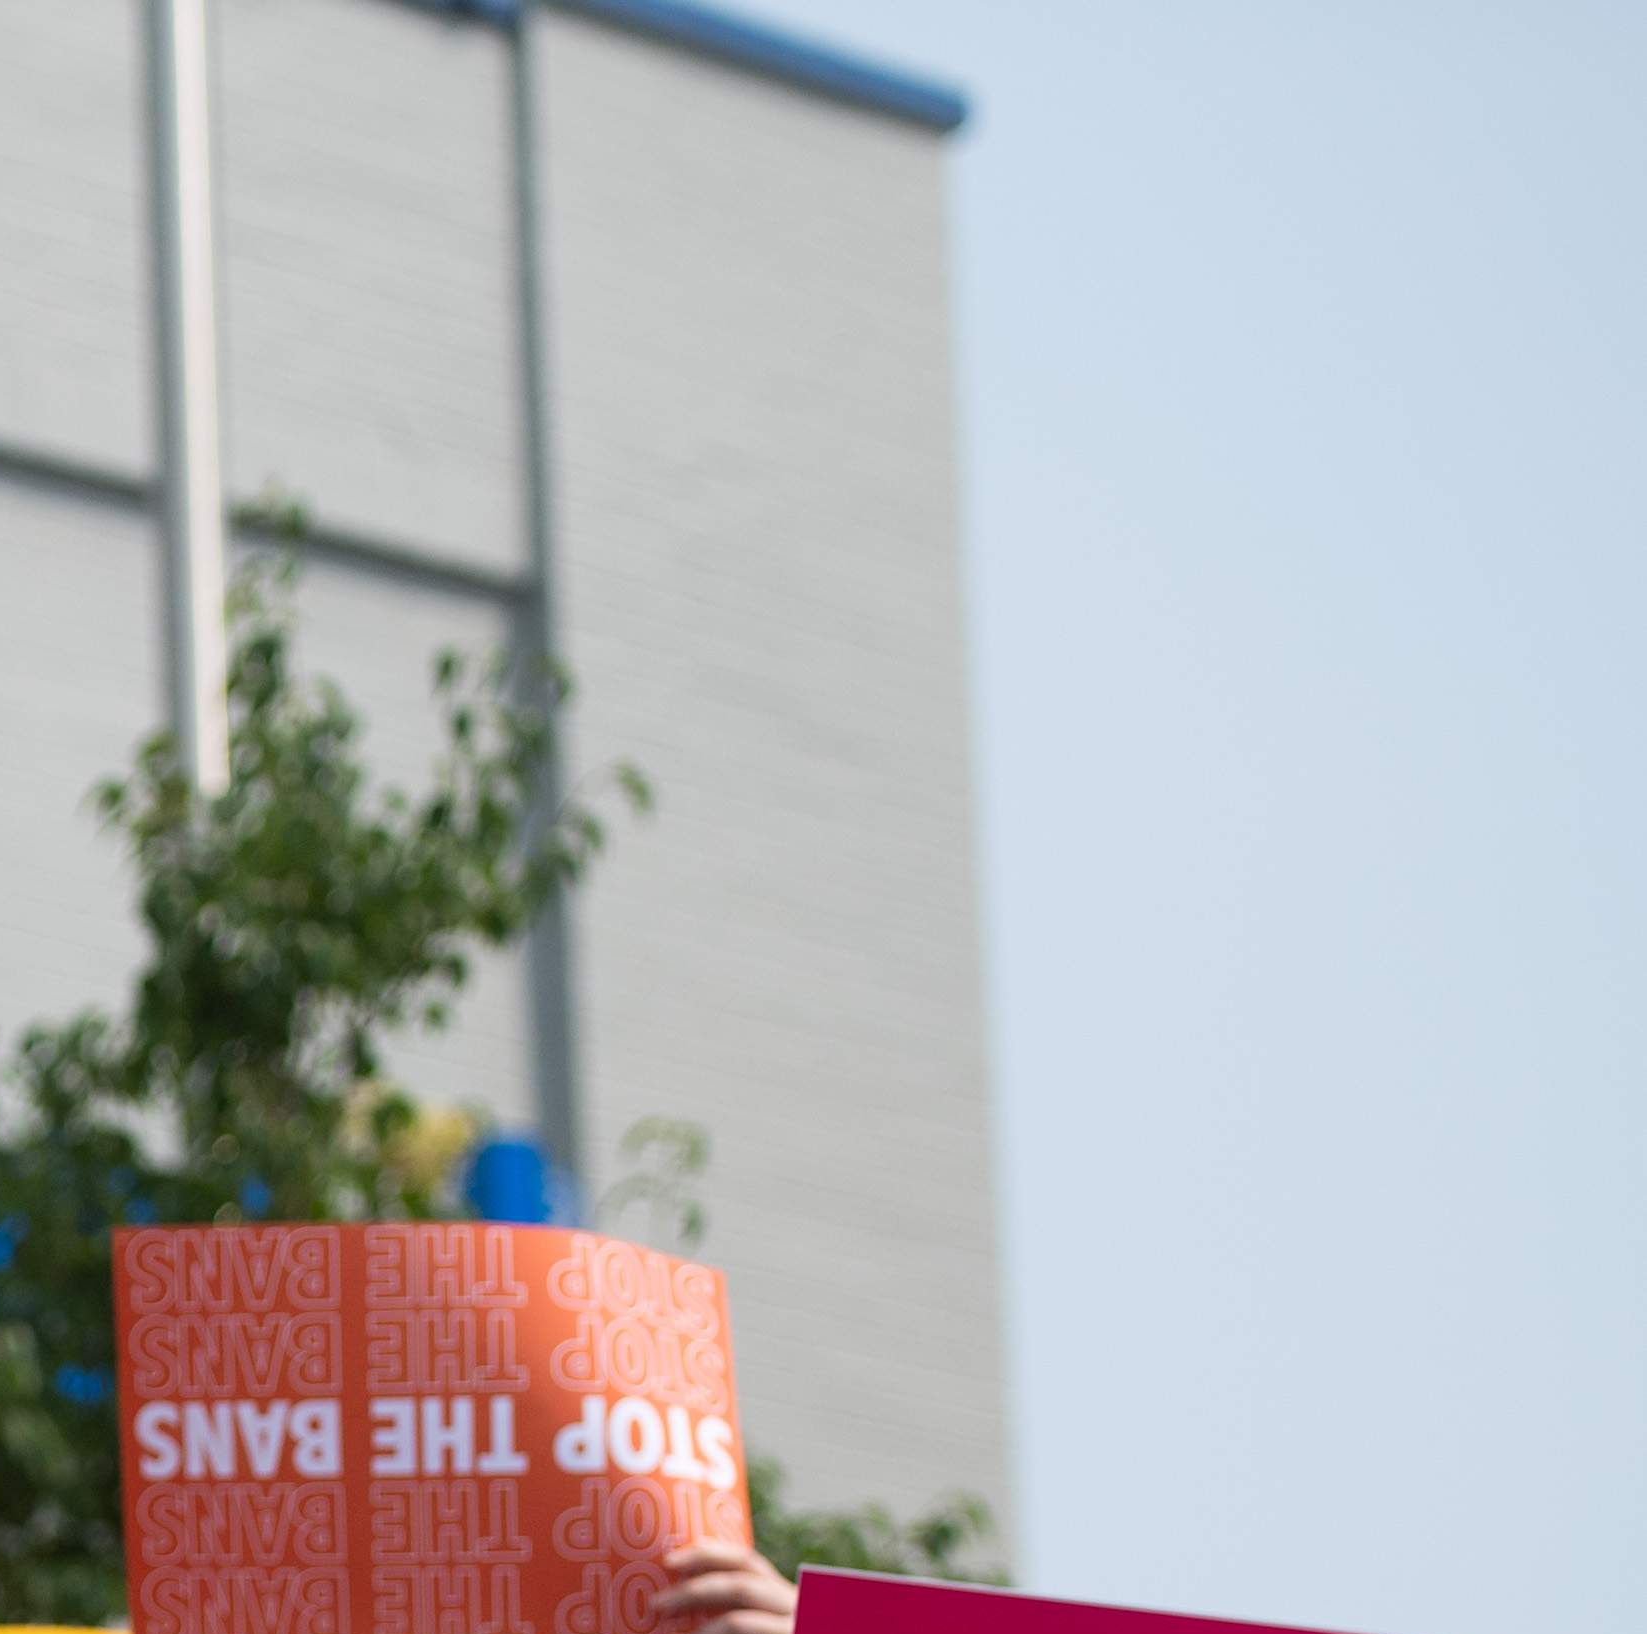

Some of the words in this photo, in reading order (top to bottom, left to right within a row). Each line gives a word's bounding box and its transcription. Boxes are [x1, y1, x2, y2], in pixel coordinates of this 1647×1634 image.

[124, 1226, 342, 1315] BANS
[364, 1223, 529, 1310] THE
[547, 1233, 721, 1341] STOP
[127, 1311, 344, 1399] BANS
[365, 1308, 531, 1394] THE
[548, 1311, 730, 1418] STOP
[133, 1397, 344, 1482] BANS
[369, 1394, 529, 1480] THE
[552, 1394, 737, 1491] STOP
[136, 1481, 346, 1568] BANS
[369, 1478, 533, 1564] THE
